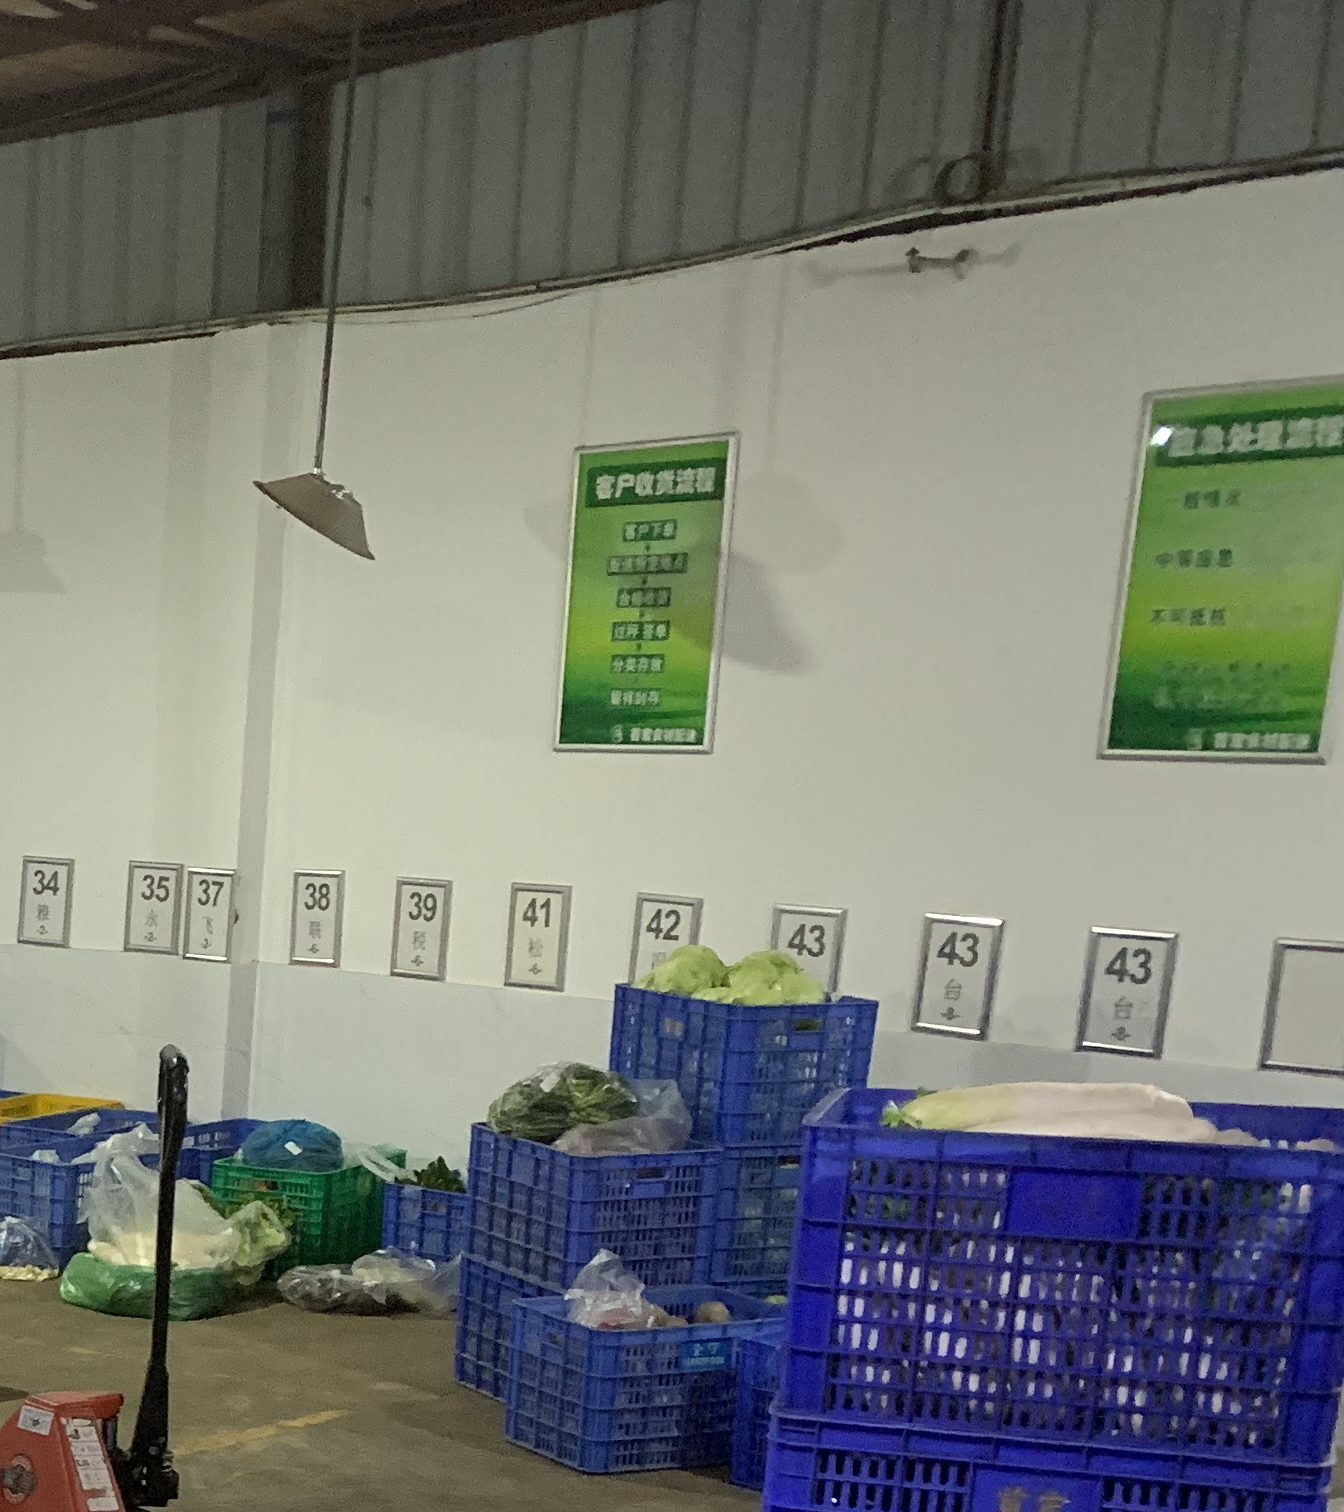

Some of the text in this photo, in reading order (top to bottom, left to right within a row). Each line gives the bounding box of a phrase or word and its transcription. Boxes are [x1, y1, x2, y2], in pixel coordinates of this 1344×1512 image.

[32, 869, 60, 897] 34
[140, 874, 171, 902] 35
[197, 879, 225, 907] 37
[302, 882, 331, 912] 38
[407, 891, 438, 922] 39
[521, 896, 552, 929] 41
[645, 908, 681, 942] 42
[786, 923, 827, 959] 43
[936, 931, 981, 968] 43
[1104, 946, 1153, 986] 43
[943, 978, 963, 1001] 台
[1114, 996, 1134, 1020] 台
